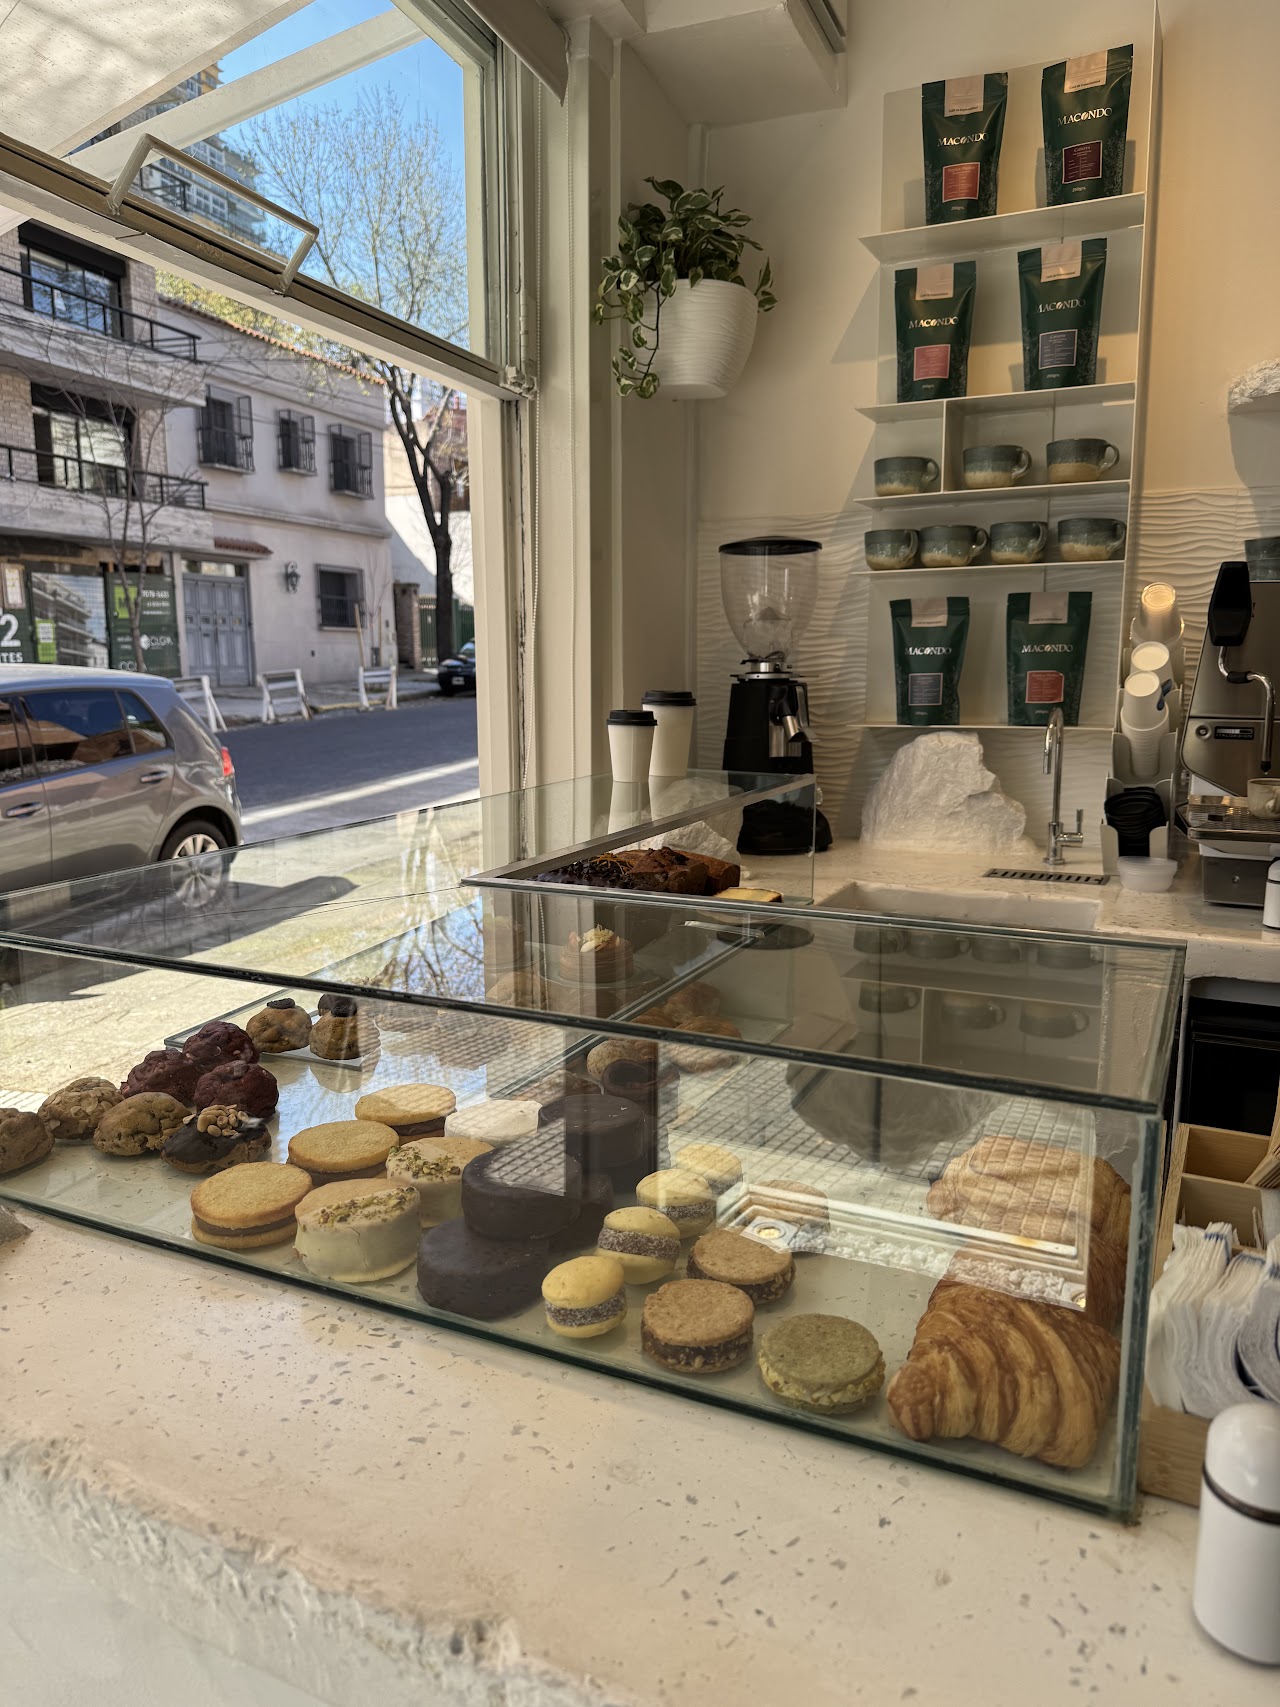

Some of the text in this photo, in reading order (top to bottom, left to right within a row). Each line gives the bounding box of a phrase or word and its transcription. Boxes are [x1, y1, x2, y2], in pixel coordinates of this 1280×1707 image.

[1057, 107, 1113, 128] MACONDO
[937, 132, 989, 147] MACONDO
[1034, 299, 1086, 315] MACONDO
[908, 316, 960, 329] MACONDO
[904, 646, 952, 656] MACONDO
[1021, 644, 1074, 654] MACONDO
